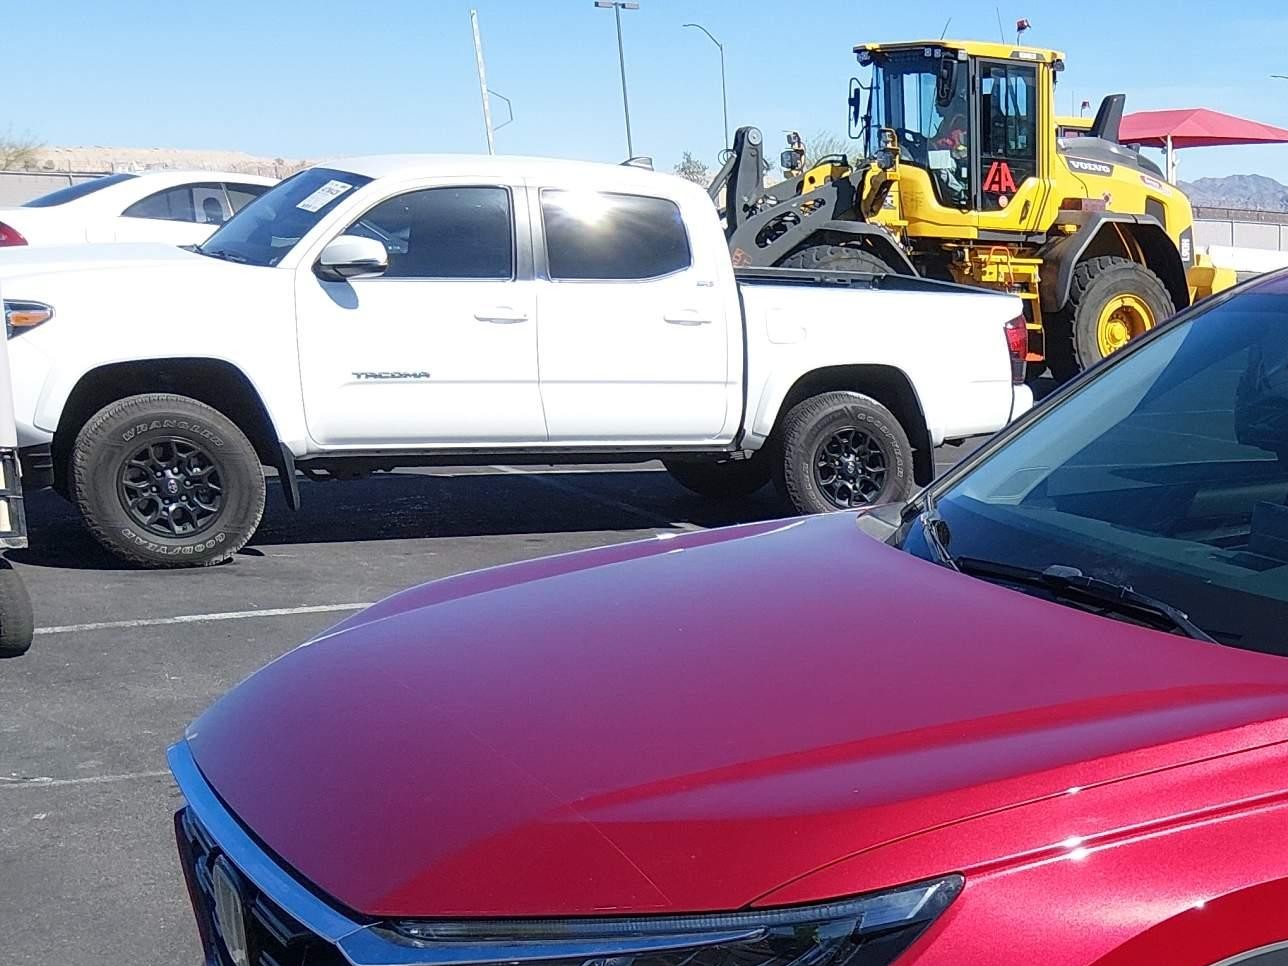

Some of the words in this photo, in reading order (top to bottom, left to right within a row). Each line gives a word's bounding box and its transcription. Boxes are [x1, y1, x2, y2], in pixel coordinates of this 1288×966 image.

[1069, 160, 1111, 173] VOLVO
[351, 371, 430, 379] TACOMA
[122, 419, 223, 447] WRANGLER
[857, 412, 904, 478] GOODYEAR
[121, 528, 226, 555] GOODYEAR
